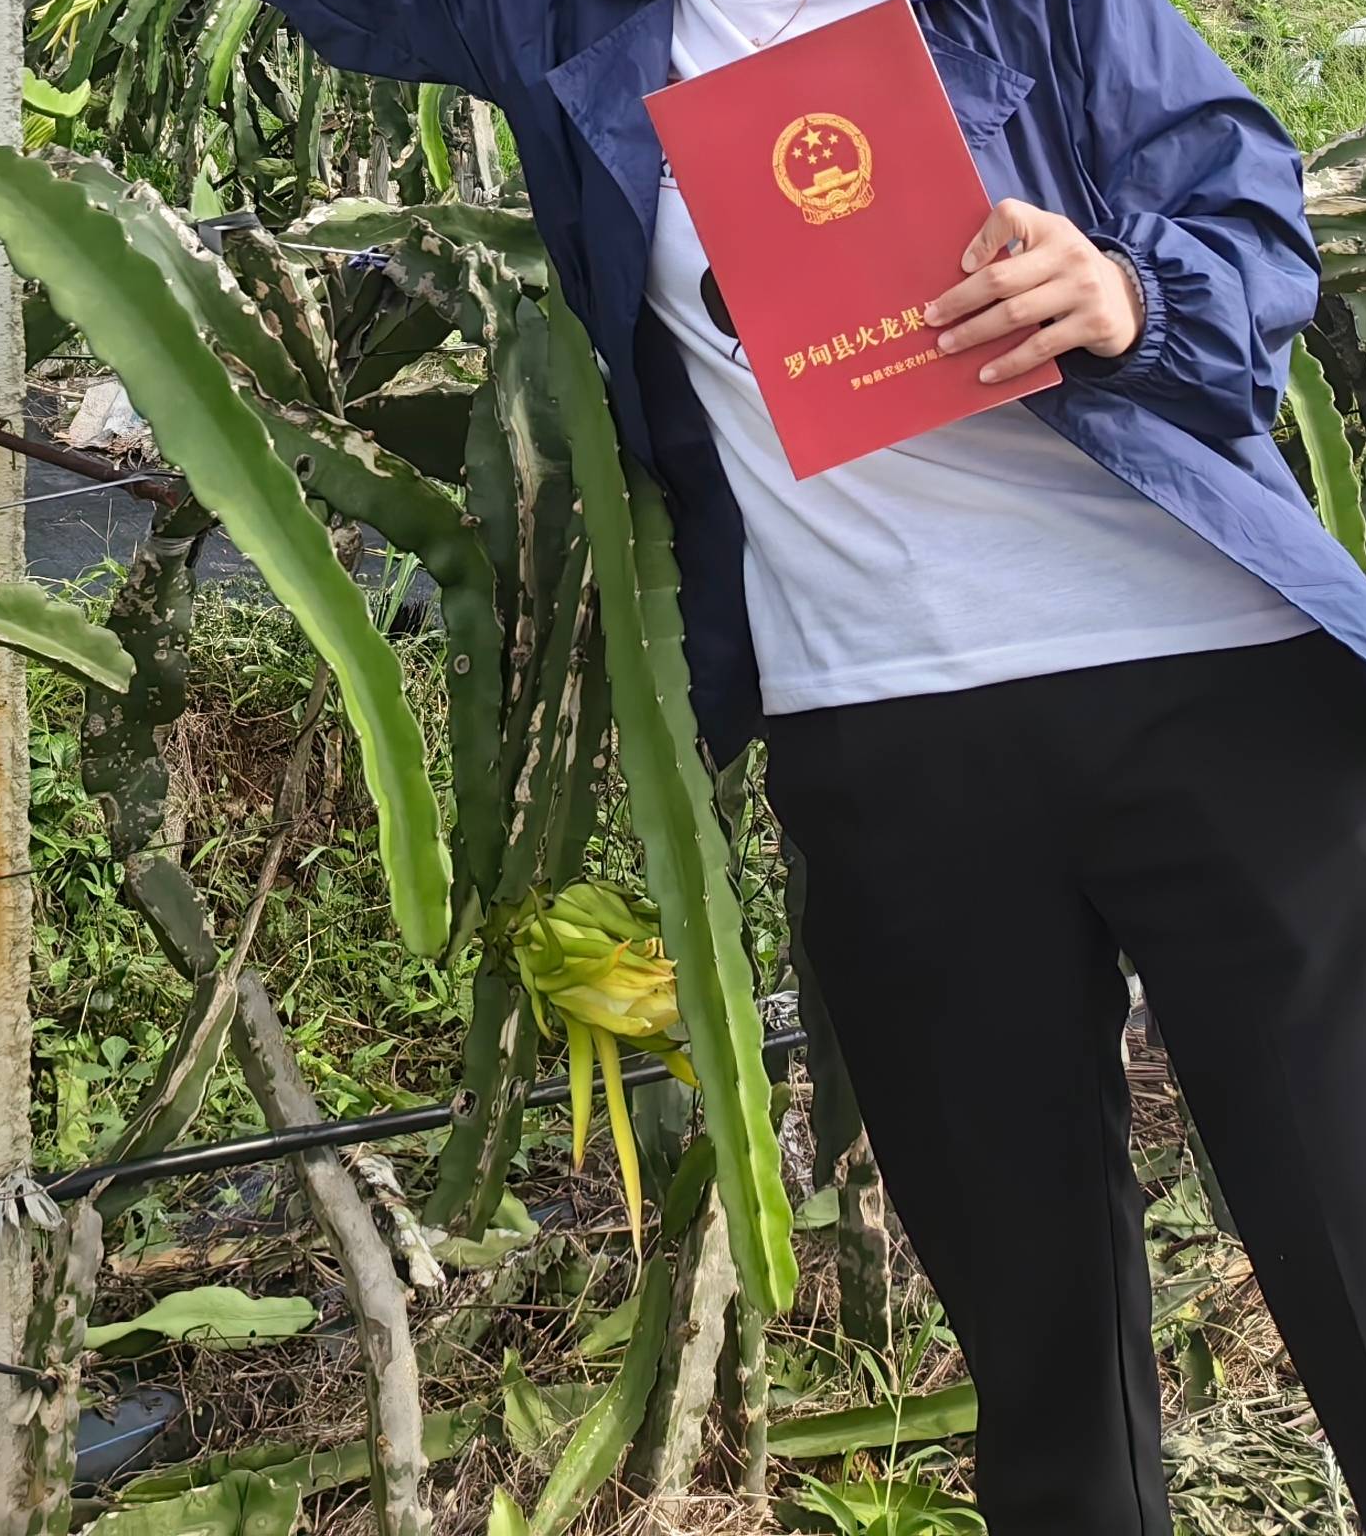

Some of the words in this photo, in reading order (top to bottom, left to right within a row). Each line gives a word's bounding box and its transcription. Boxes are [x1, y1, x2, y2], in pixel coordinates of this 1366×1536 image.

[783, 302, 937, 380] 罗甸县火龙果
